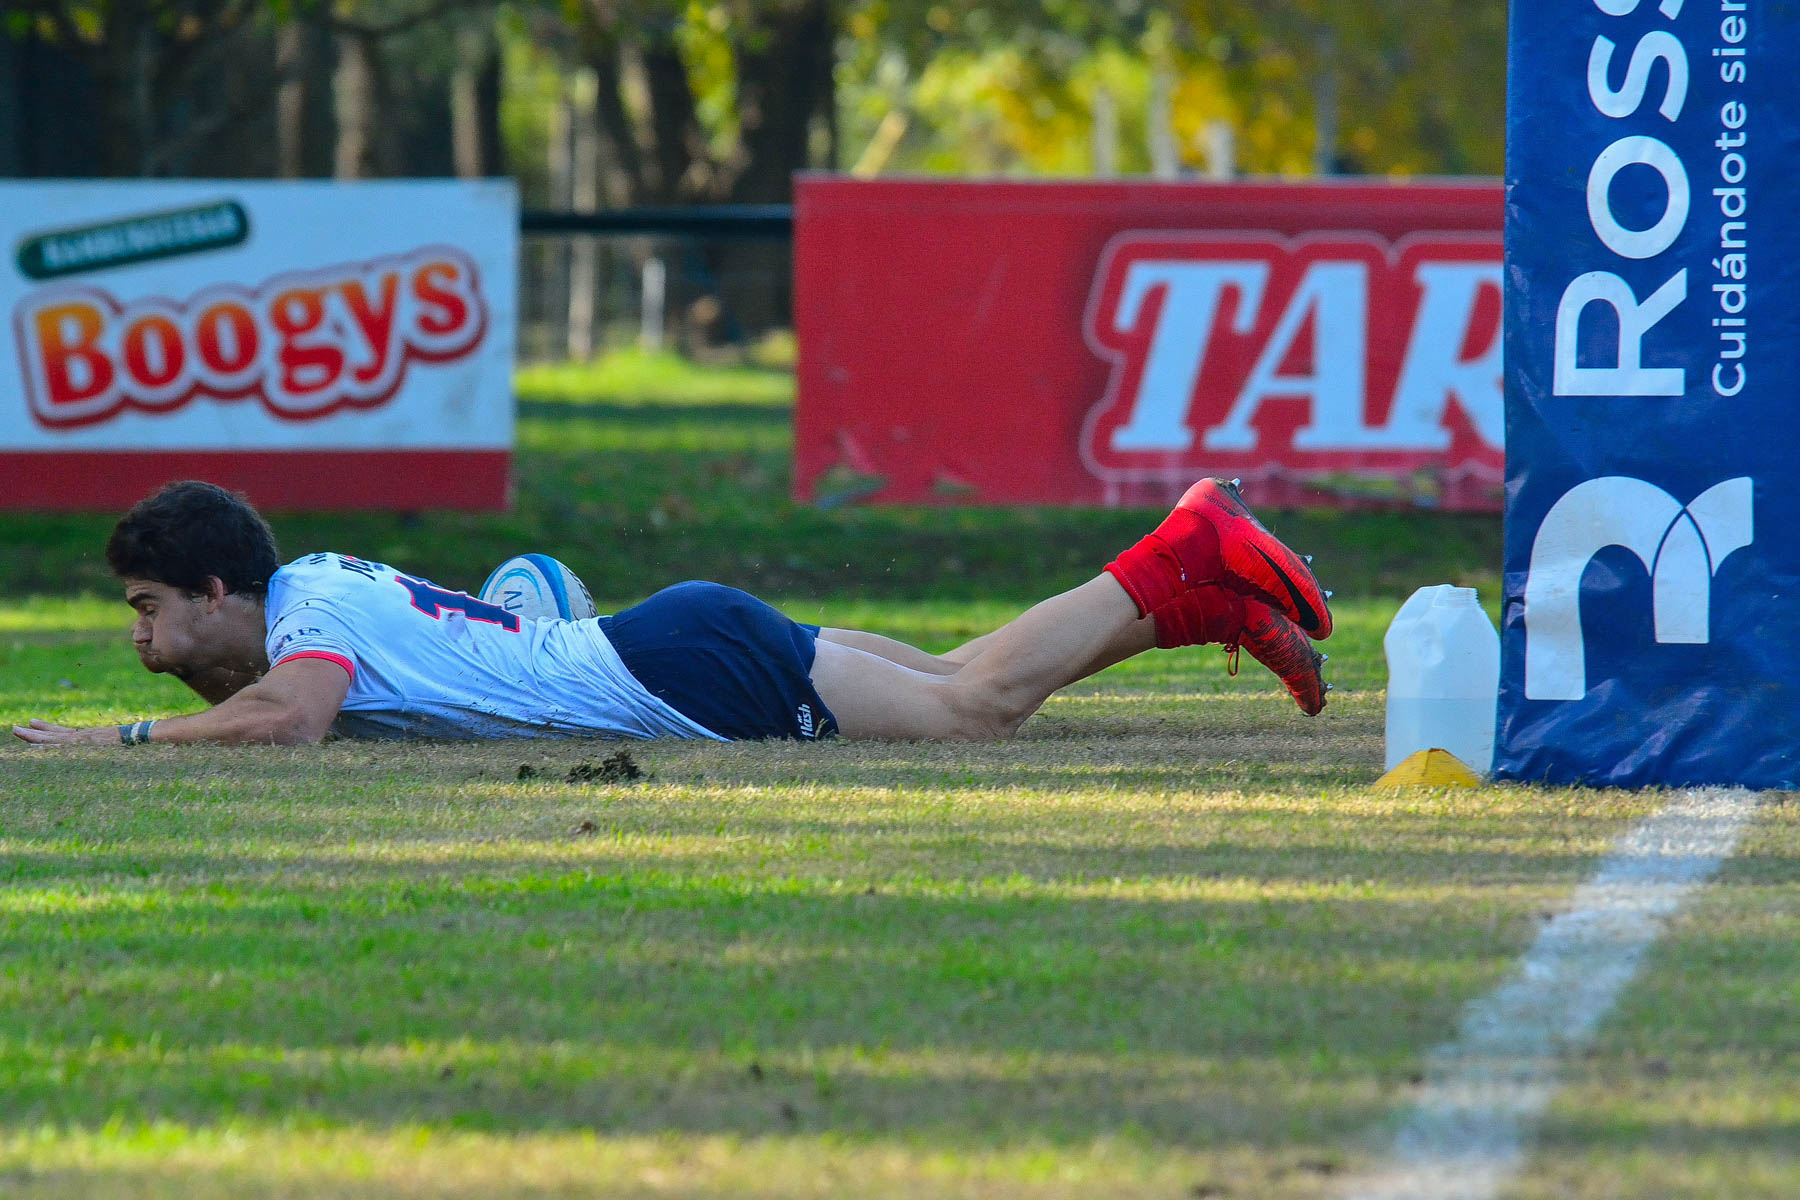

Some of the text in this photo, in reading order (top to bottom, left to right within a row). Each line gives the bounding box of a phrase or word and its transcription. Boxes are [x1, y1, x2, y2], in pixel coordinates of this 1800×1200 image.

[1553, 0, 1690, 396] ROS
[1712, 101, 1747, 397] Cuidándote
[35, 261, 468, 405] Boogys
[1110, 259, 1505, 452] TAR
